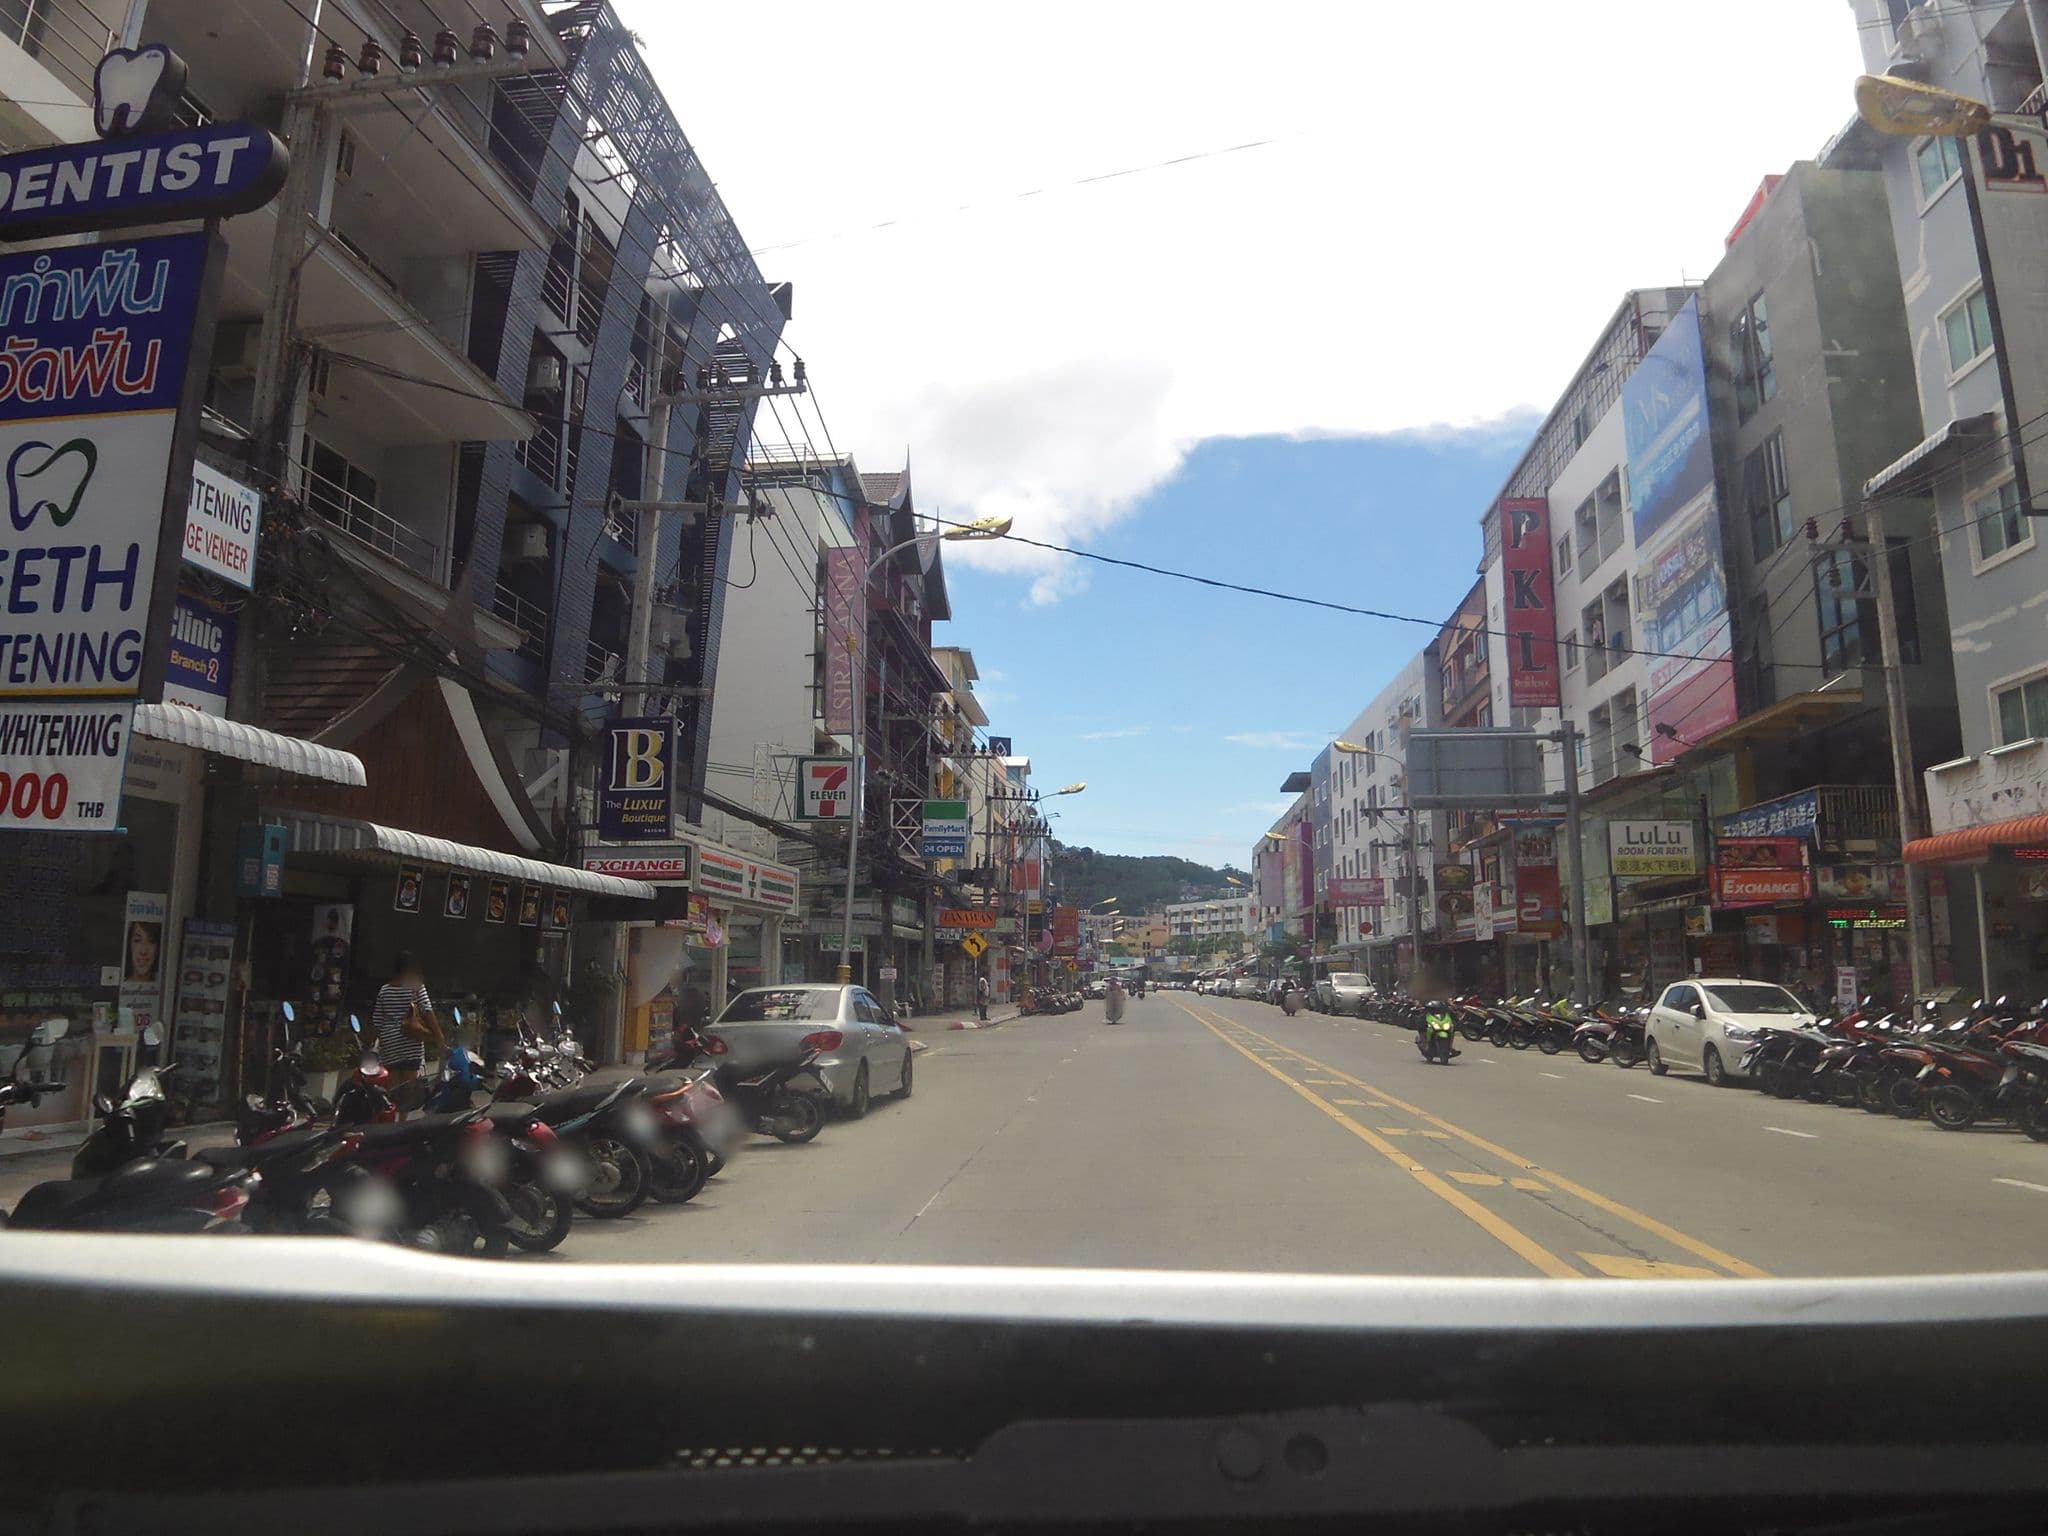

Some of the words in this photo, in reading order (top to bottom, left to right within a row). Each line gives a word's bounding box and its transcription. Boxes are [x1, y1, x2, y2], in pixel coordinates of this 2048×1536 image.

[205, 530, 248, 574] VENEER
[0, 543, 139, 613] ETH
[170, 650, 206, 674] Branch
[207, 657, 219, 684] 2
[0, 714, 122, 757] WHITENING
[78, 802, 104, 818] THB
[622, 813, 667, 824] Boutique
[924, 824, 965, 834] FamilyMart
[1625, 825, 1681, 845] LuLu
[936, 845, 963, 853] OPEN
[1617, 847, 1645, 855] ROOM
[1646, 847, 1664, 855] FOR
[1665, 847, 1688, 855] RENT
[585, 859, 683, 872] EXCHANGE
